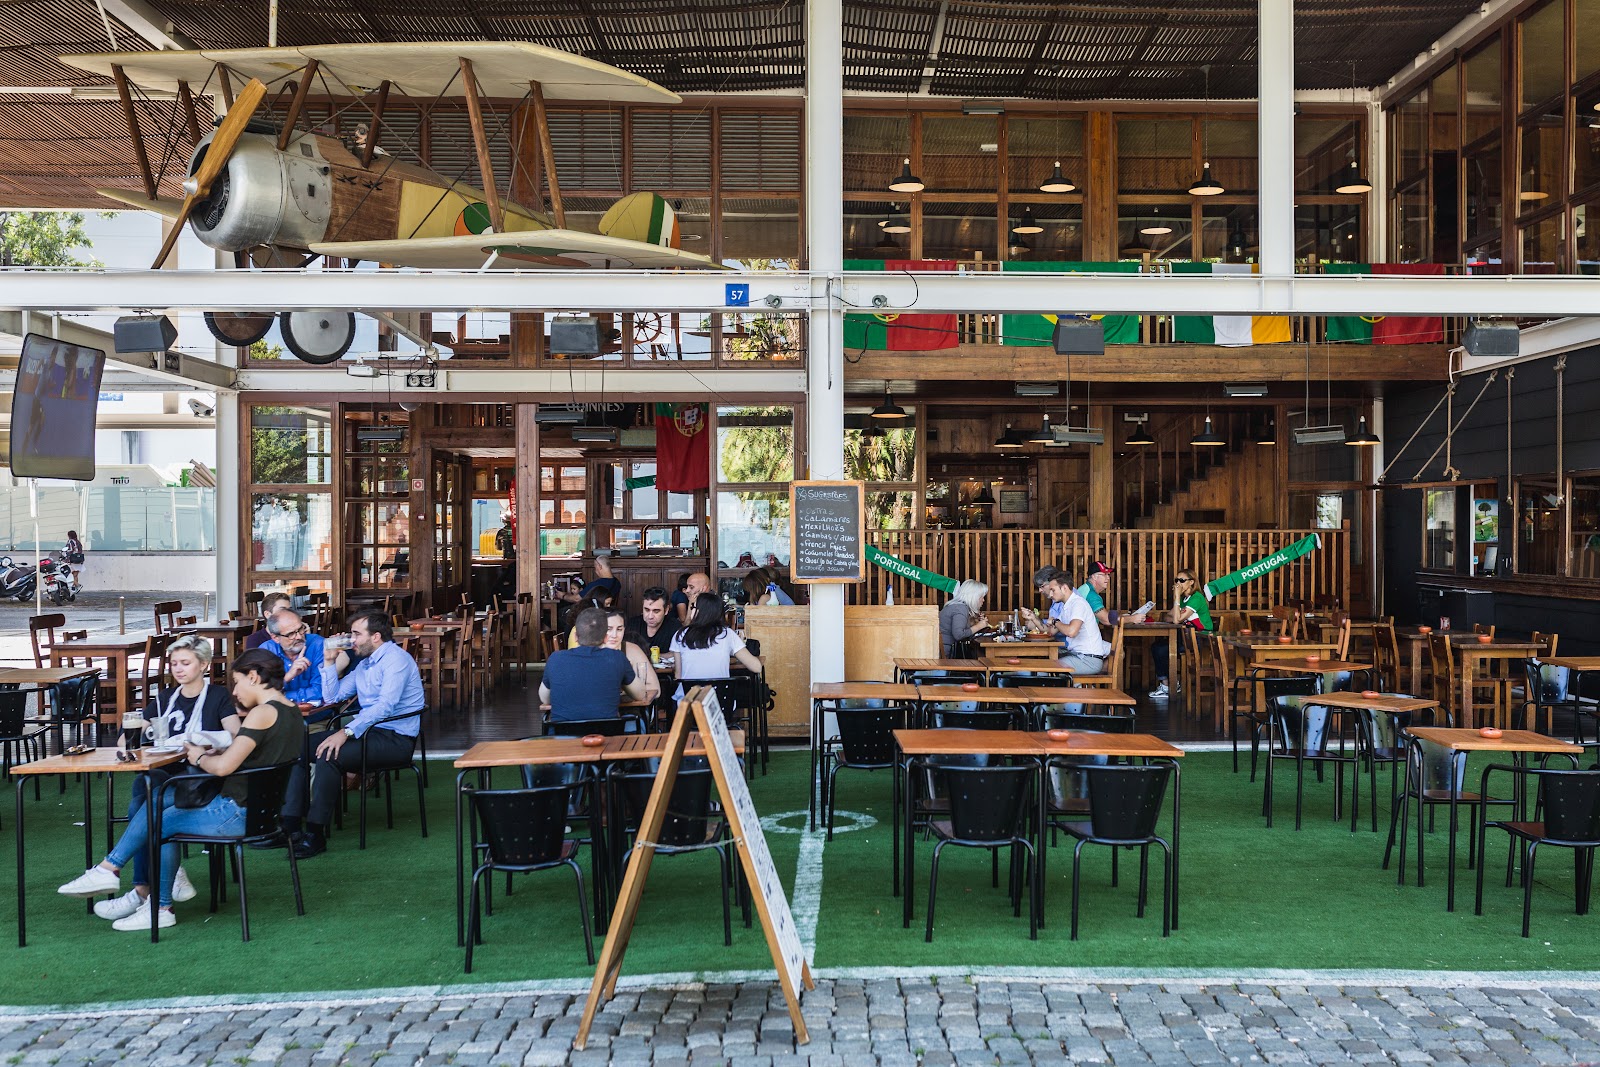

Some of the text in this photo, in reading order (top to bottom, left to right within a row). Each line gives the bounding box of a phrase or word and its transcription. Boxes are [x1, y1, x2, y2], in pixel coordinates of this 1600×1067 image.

[731, 290, 744, 300] 57
[565, 402, 625, 412] GUINNESS
[873, 553, 921, 580] PORTUGAL
[1241, 553, 1289, 580] PORTUGAL
